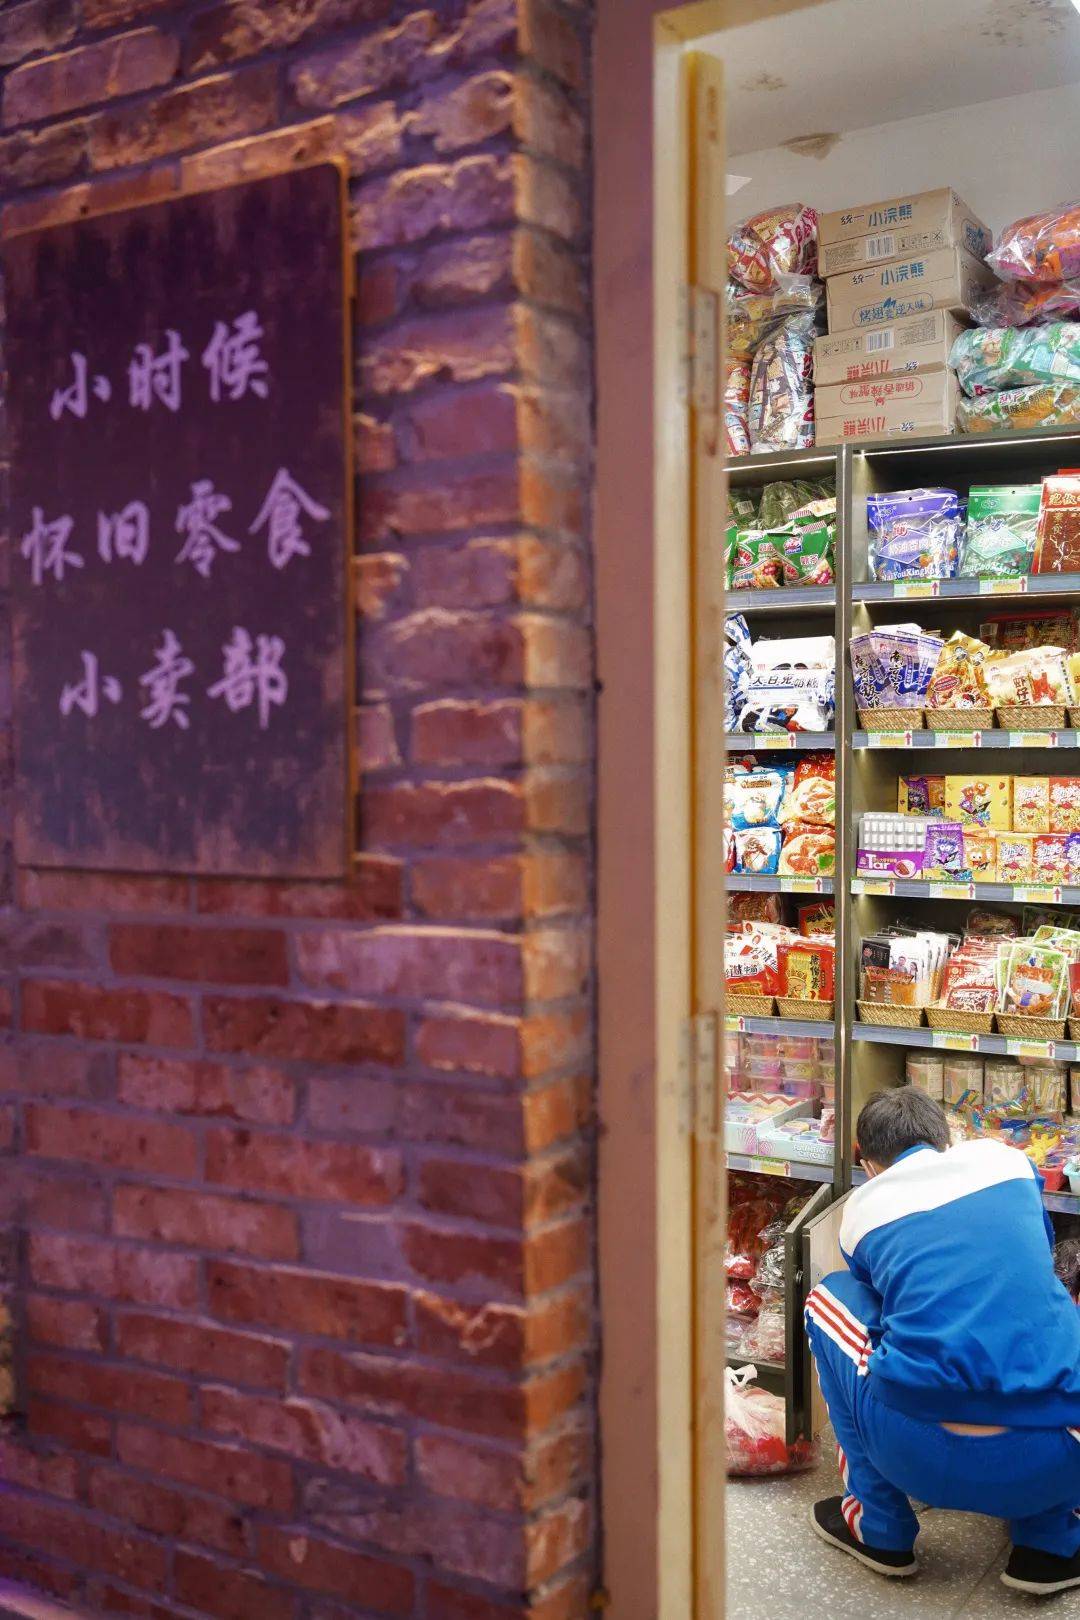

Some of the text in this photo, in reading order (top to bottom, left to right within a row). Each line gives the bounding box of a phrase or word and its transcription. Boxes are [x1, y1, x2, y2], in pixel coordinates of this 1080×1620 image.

[840, 204, 912, 227] 统一 小浣熊
[852, 262, 924, 286] 统一 小浣熊
[50, 311, 269, 420] 小时候
[846, 359, 889, 380] 小浣熊
[843, 416, 886, 436] 小浣熊
[21, 467, 331, 586] 怀旧零食
[60, 626, 288, 730] 小卖部
